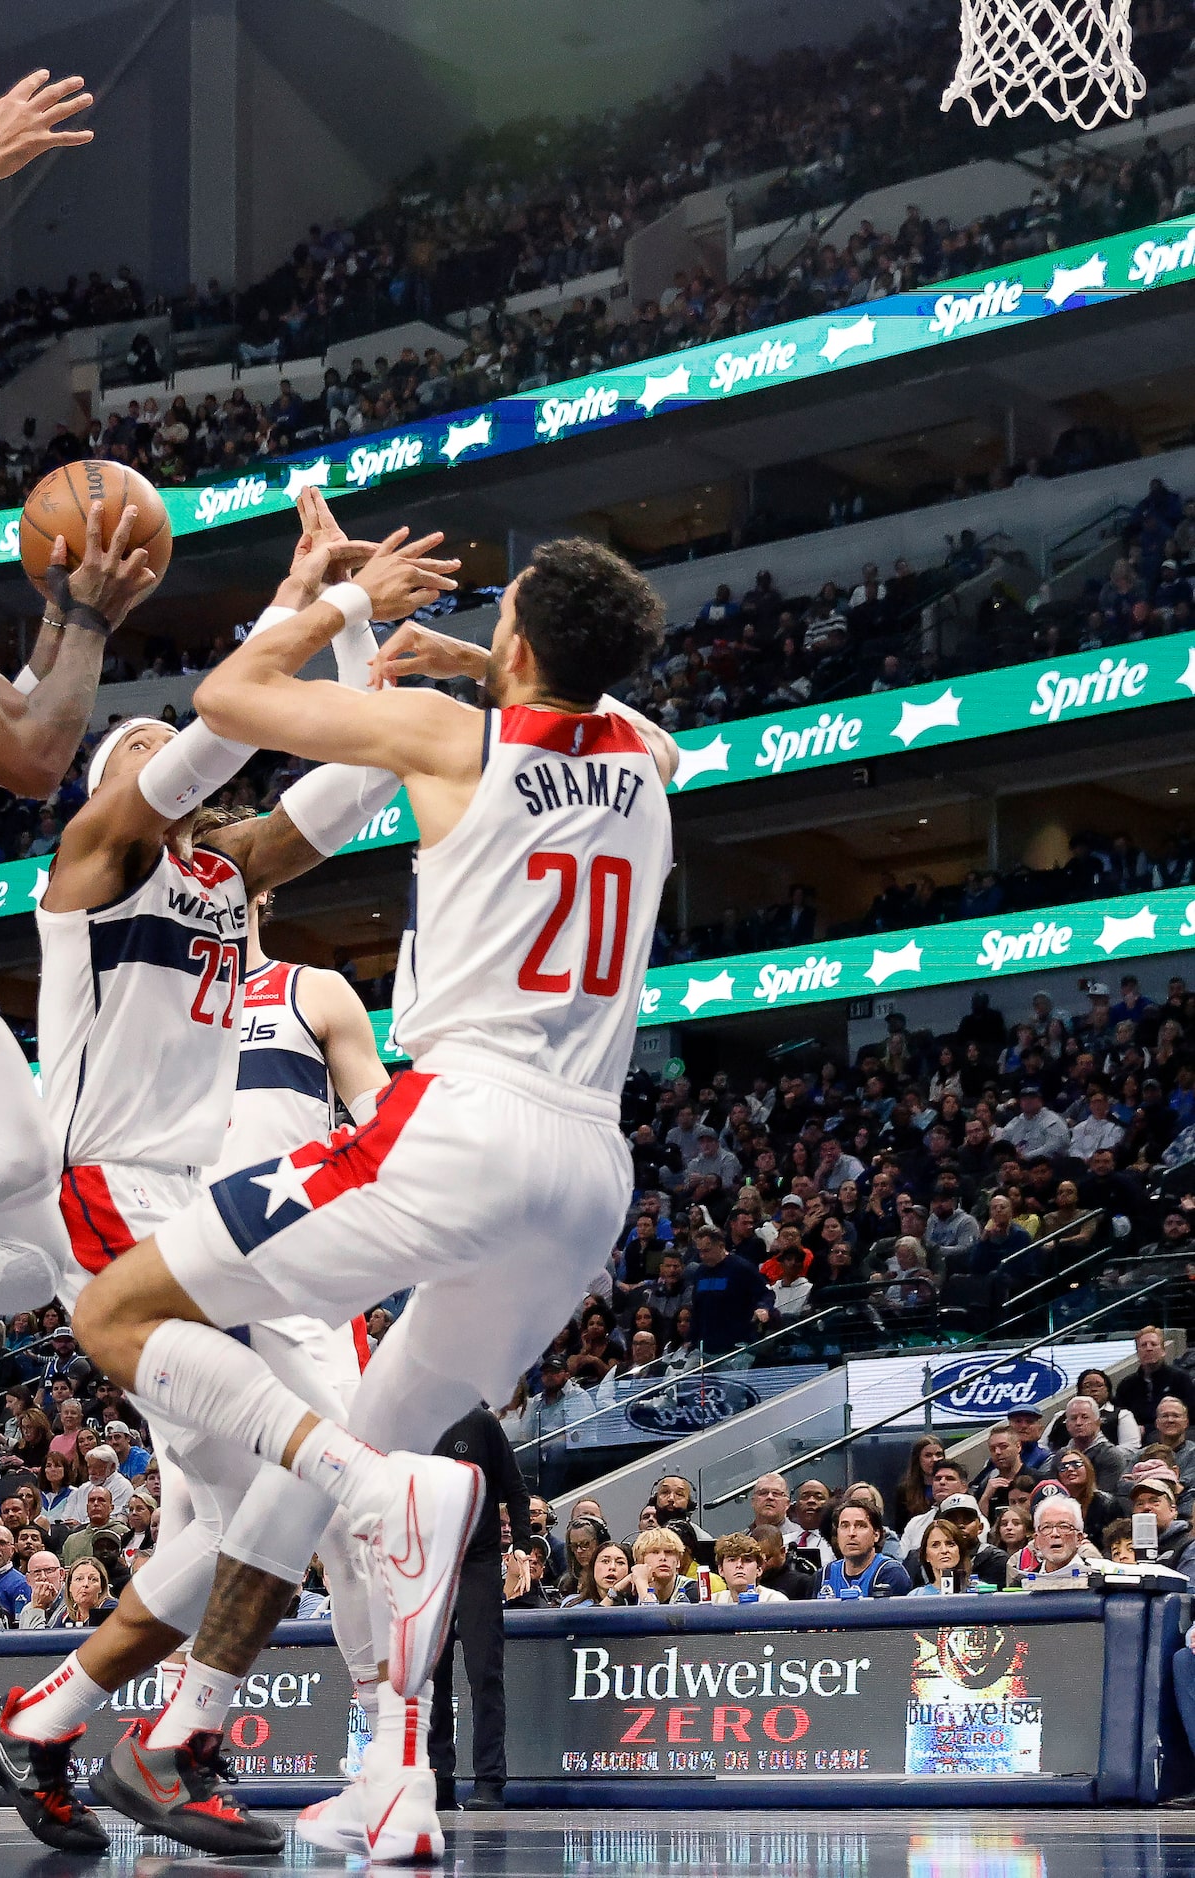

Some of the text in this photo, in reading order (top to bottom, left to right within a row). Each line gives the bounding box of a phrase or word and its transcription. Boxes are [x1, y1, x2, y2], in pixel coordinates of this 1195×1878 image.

[1128, 228, 1195, 285] Spri
[928, 280, 1023, 336] Sprite
[709, 339, 797, 392] Sprite
[536, 385, 619, 437] Sprite
[346, 437, 424, 482] Sprite
[195, 477, 267, 522] Sprite
[1030, 658, 1149, 722] Sprite
[755, 713, 862, 773] Sprite
[515, 762, 644, 818] SHAMET
[518, 852, 632, 997] 20
[976, 921, 1073, 970] Sprite
[245, 993, 279, 1001] obinhood
[753, 956, 842, 1003] Sprite
[950, 1365, 1038, 1406] Ford
[95, 1662, 320, 1711] udiser
[569, 1645, 871, 1700] Budweiser
[115, 1713, 270, 1749] ZO
[620, 1703, 811, 1743] ZERO
[272, 1753, 317, 1774] GAME
[562, 1750, 587, 1771] 0%
[667, 1750, 716, 1771] 100%
[724, 1750, 749, 1771] ON
[757, 1750, 806, 1771] YOUR
[814, 1750, 870, 1771] GAME
